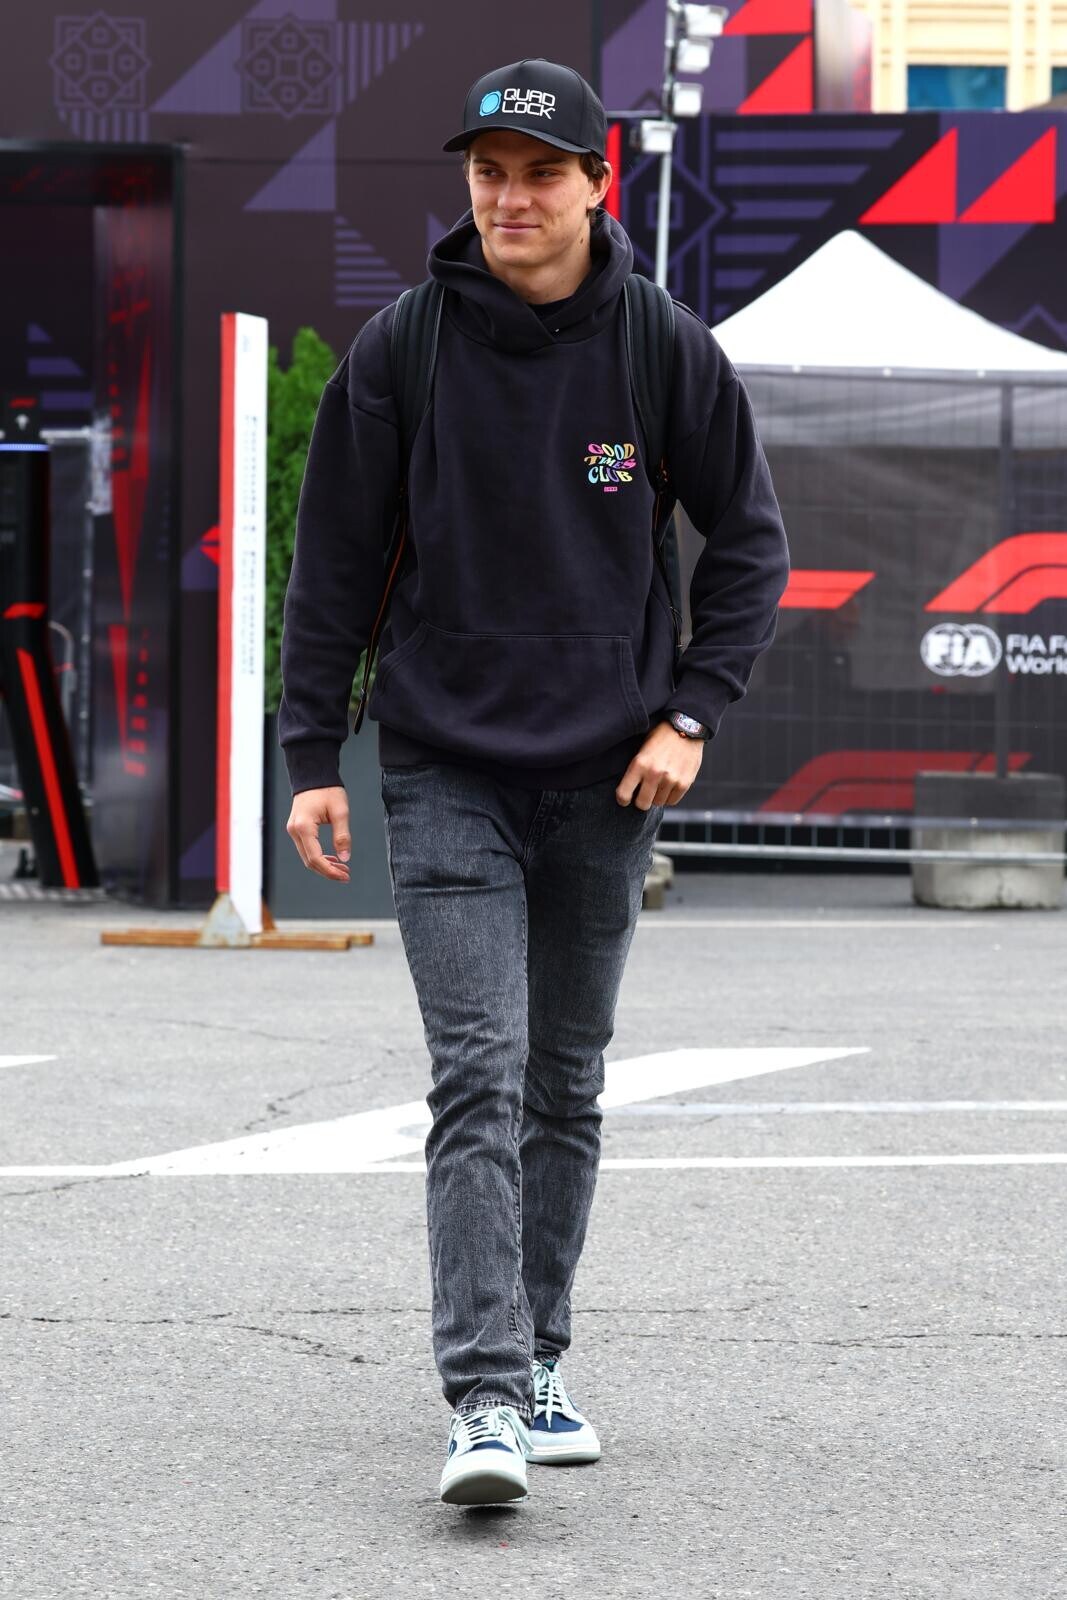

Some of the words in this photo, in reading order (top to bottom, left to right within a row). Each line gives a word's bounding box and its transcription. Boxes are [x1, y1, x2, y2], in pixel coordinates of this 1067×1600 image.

[504, 88, 556, 107] QUAD
[502, 101, 556, 120] LOCK
[588, 443, 635, 461] GOOD
[583, 455, 637, 469] TIMES
[588, 465, 633, 484] CLUB
[1006, 633, 1047, 655] FIA
[1049, 634, 1067, 655] F
